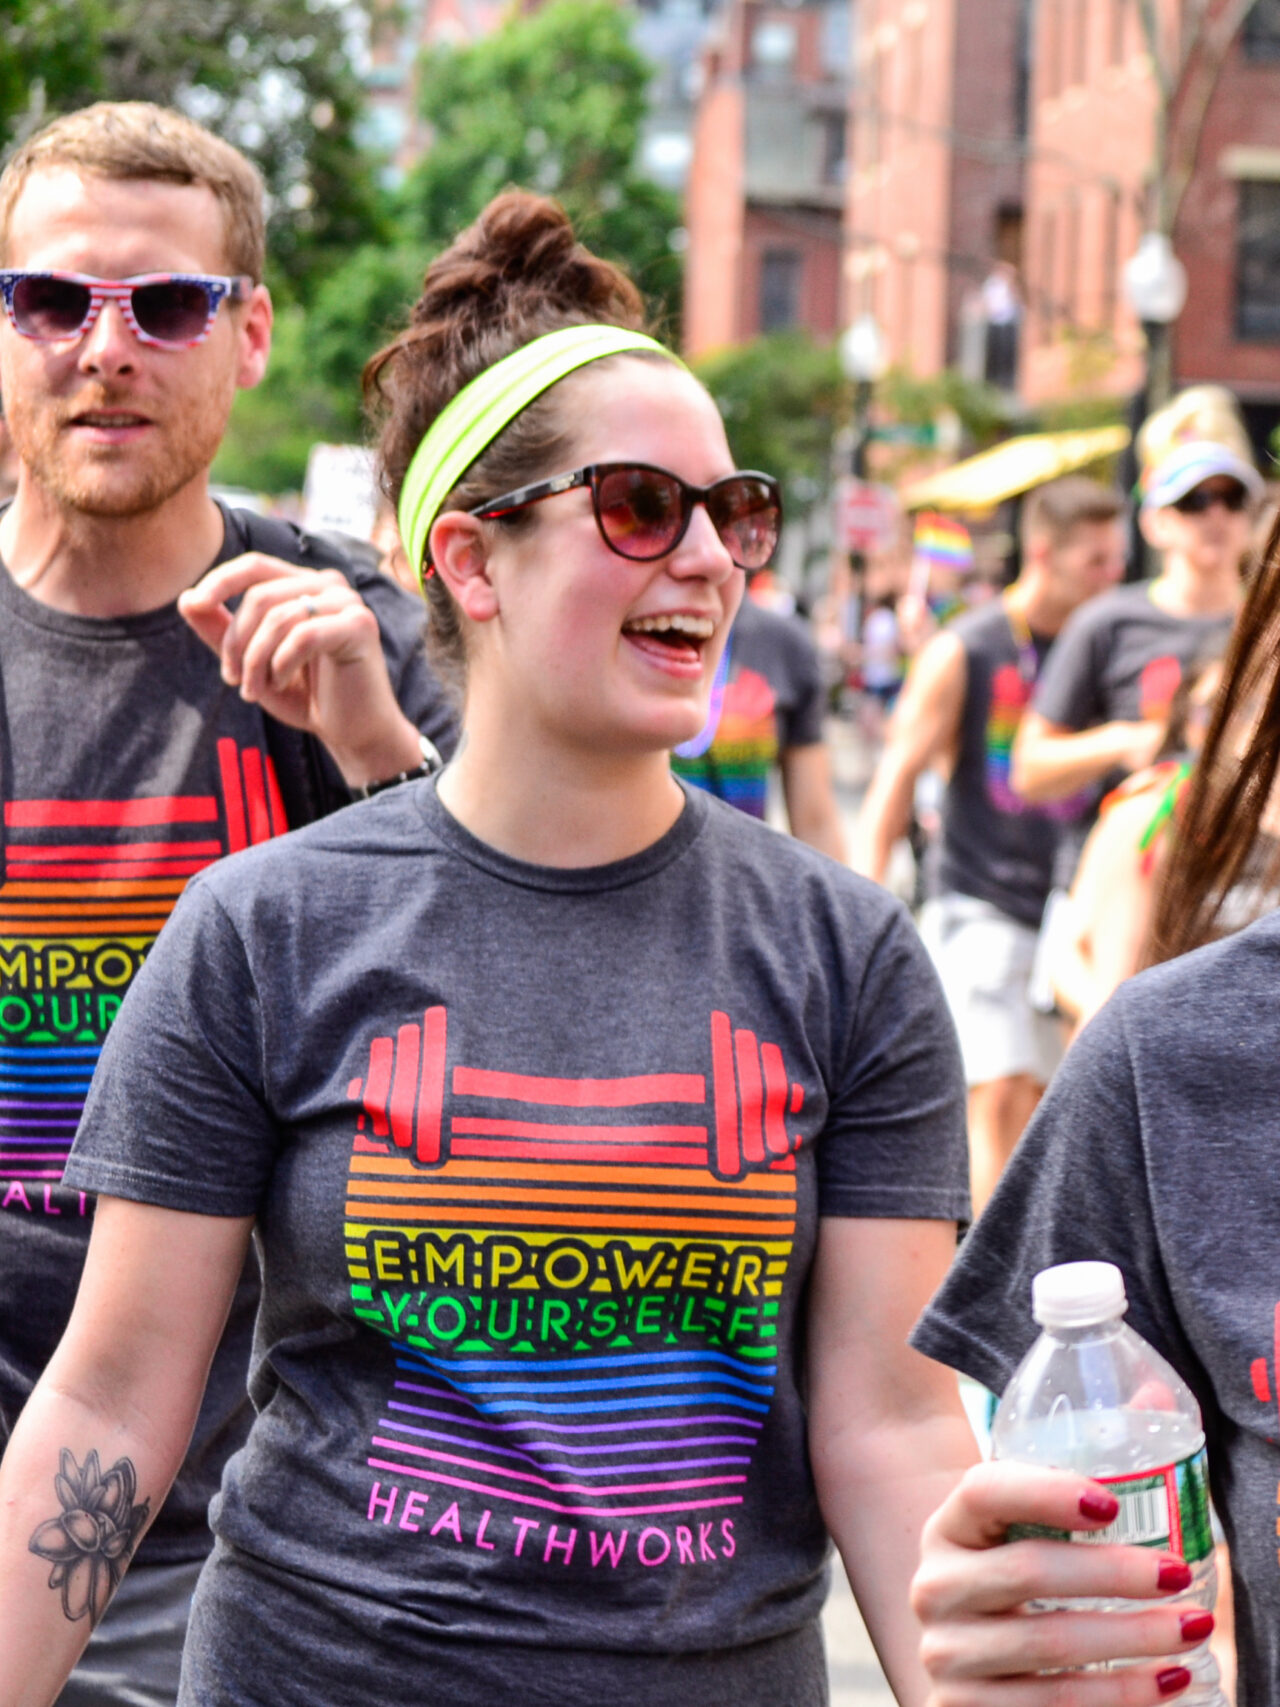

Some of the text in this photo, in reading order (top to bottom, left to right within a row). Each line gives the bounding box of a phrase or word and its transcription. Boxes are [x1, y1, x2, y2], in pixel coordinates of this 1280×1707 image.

[374, 1238, 763, 1297] EMPOWER
[381, 1289, 757, 1343] YOURSELF
[366, 1481, 737, 1569] HEALTHWORKS
